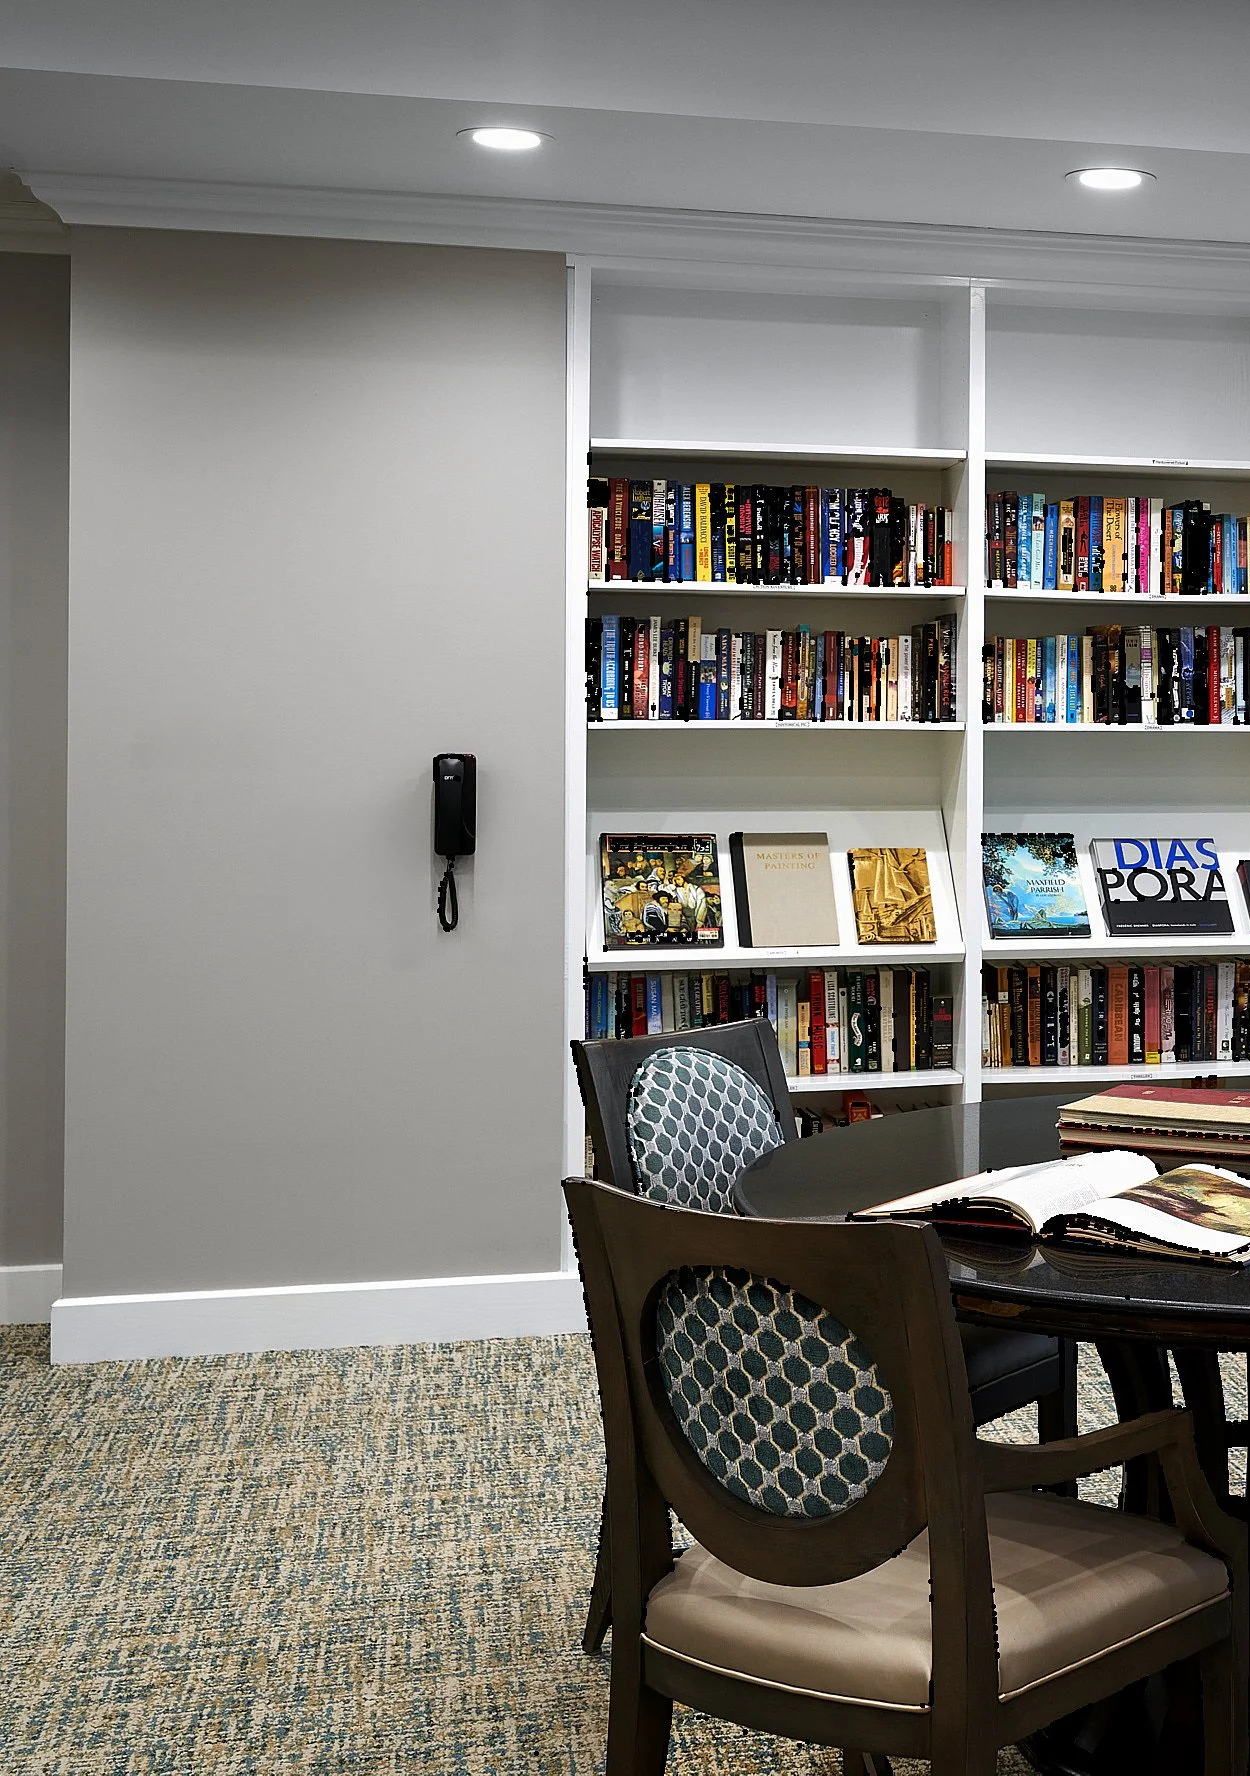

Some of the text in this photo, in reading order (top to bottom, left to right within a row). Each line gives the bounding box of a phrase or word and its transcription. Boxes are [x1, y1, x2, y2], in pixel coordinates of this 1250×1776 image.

[615, 516, 623, 529] CODE
[653, 490, 664, 526] JOHANSEN
[683, 487, 691, 529] ALEX BERENSON
[700, 497, 708, 543] DAVID BALDACCI
[1106, 500, 1114, 541] The Desert
[592, 510, 601, 572] APOCALYPSE WATCH
[1115, 532, 1123, 540] of
[829, 544, 837, 576] LOCKED ON
[604, 660, 615, 690] ACCORDING
[606, 700, 615, 708] US
[765, 862, 816, 870] PAINTING
[1114, 838, 1220, 870] DIAS
[1101, 869, 1225, 901] PORA
[813, 993, 822, 1049] TRUNK MUSIC
[828, 992, 836, 1019] SCOTTOLINE
[1114, 984, 1123, 1042] CARIBBEAN
